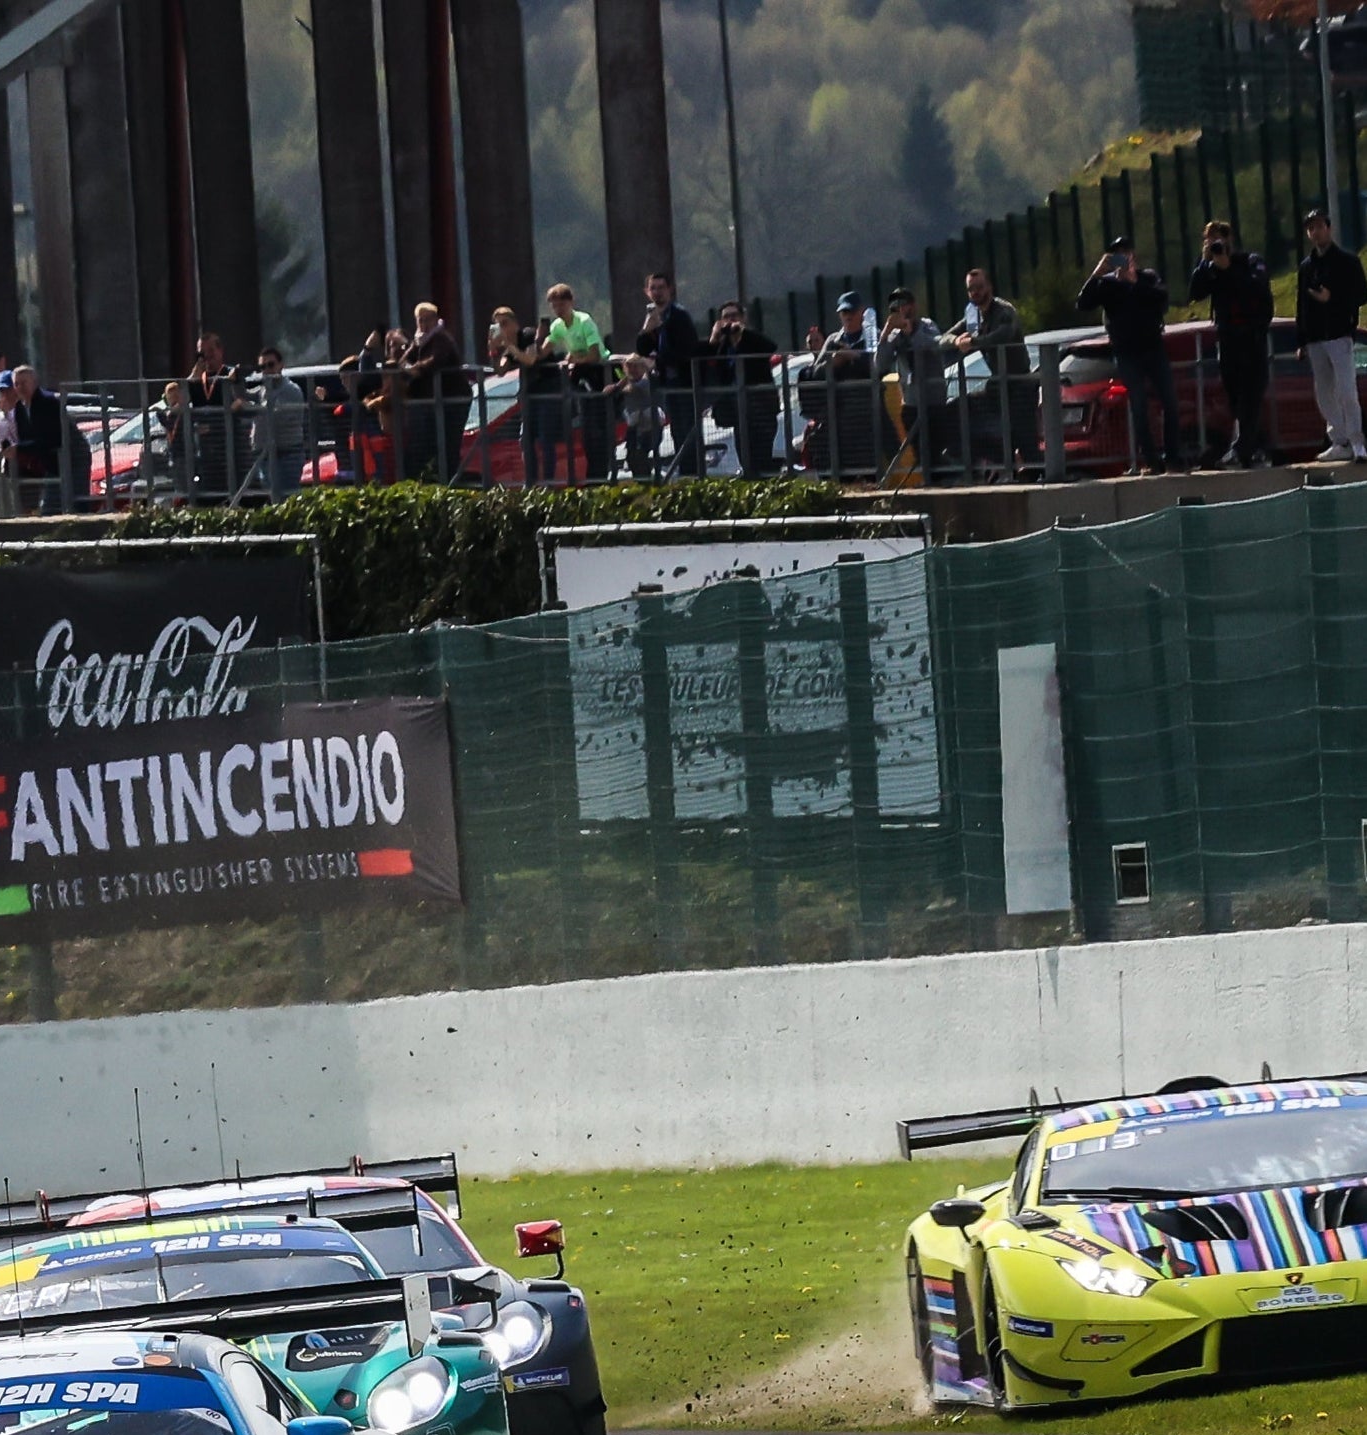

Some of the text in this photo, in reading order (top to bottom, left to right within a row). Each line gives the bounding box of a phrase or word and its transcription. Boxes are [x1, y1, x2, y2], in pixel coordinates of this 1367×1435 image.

[32, 850, 360, 912] FIRE EXTINGUISHER SYSTEMS
[150, 1234, 212, 1254] 12H
[217, 1232, 282, 1249] SPA
[61, 1381, 140, 1405] SPA
